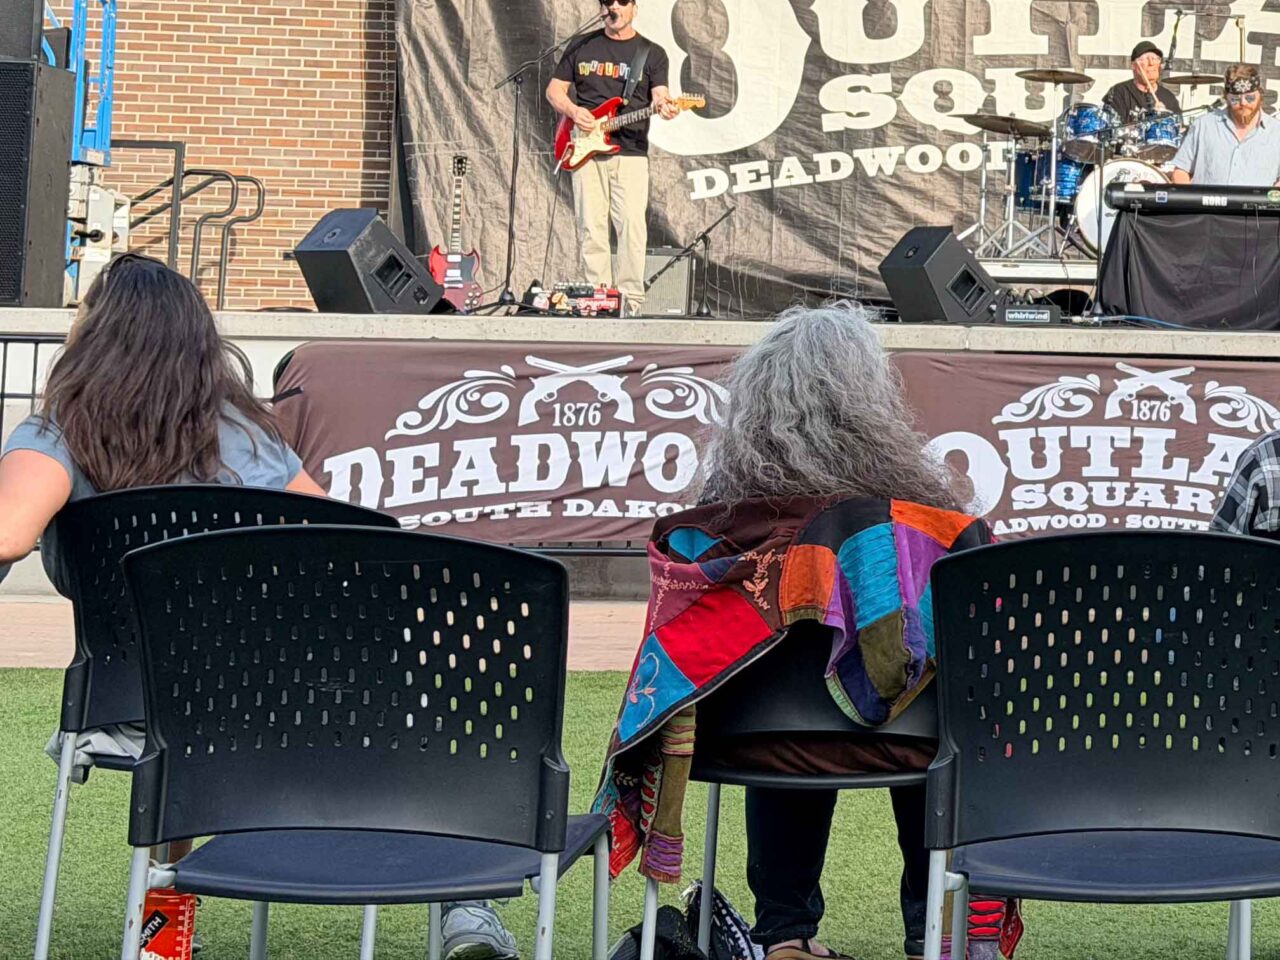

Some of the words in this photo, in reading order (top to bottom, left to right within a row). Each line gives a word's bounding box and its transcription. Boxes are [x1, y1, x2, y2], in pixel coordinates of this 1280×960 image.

[1202, 196, 1227, 206] KORG
[552, 402, 601, 427] 1876
[1131, 399, 1170, 422] 1876
[323, 430, 700, 510] DEADWO
[925, 425, 1255, 517] OUTLA
[1011, 481, 1224, 514] SQUAR
[398, 501, 552, 530] SOUTH
[563, 499, 700, 518] DAKO
[993, 514, 1106, 535] ADWOOD
